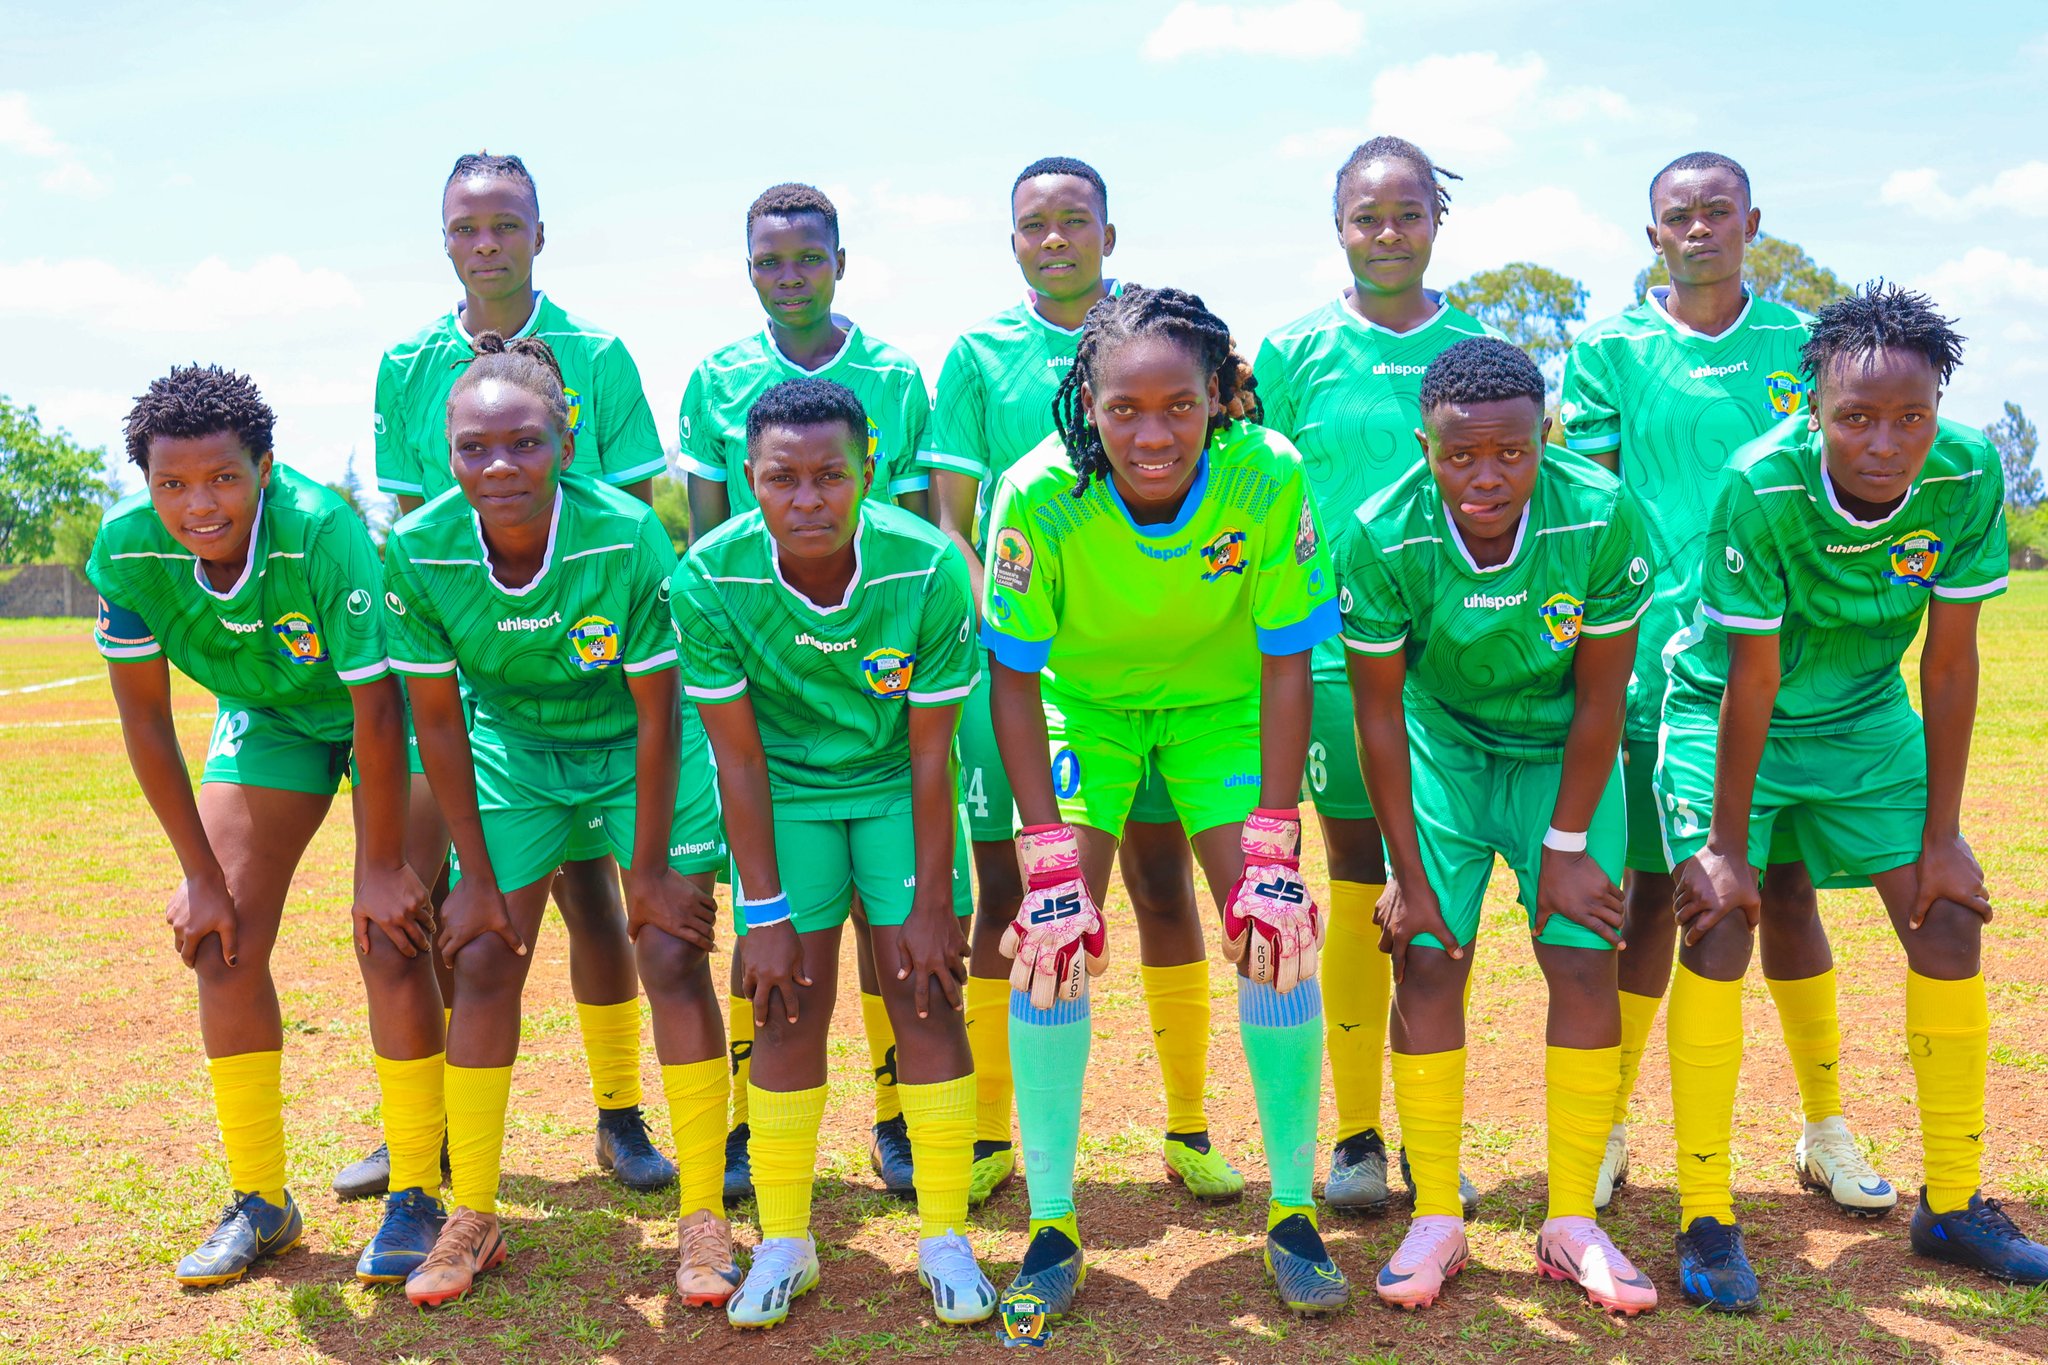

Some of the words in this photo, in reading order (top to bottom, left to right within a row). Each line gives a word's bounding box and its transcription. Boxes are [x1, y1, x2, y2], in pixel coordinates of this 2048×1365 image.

[1046, 356, 1075, 368] uhls
[1372, 363, 1427, 375] uhlspor
[1690, 360, 1749, 378] uhlsport
[1464, 590, 1528, 610] uhlsport
[497, 611, 562, 632] uhlsport
[795, 632, 857, 654] uhlsport
[1308, 741, 1328, 792] 6
[1224, 773, 1261, 787] uhlsp
[968, 767, 989, 818] 4
[669, 841, 715, 857] uhlsport
[1069, 960, 1080, 998] VALOR
[1911, 1034, 1932, 1057] 3
